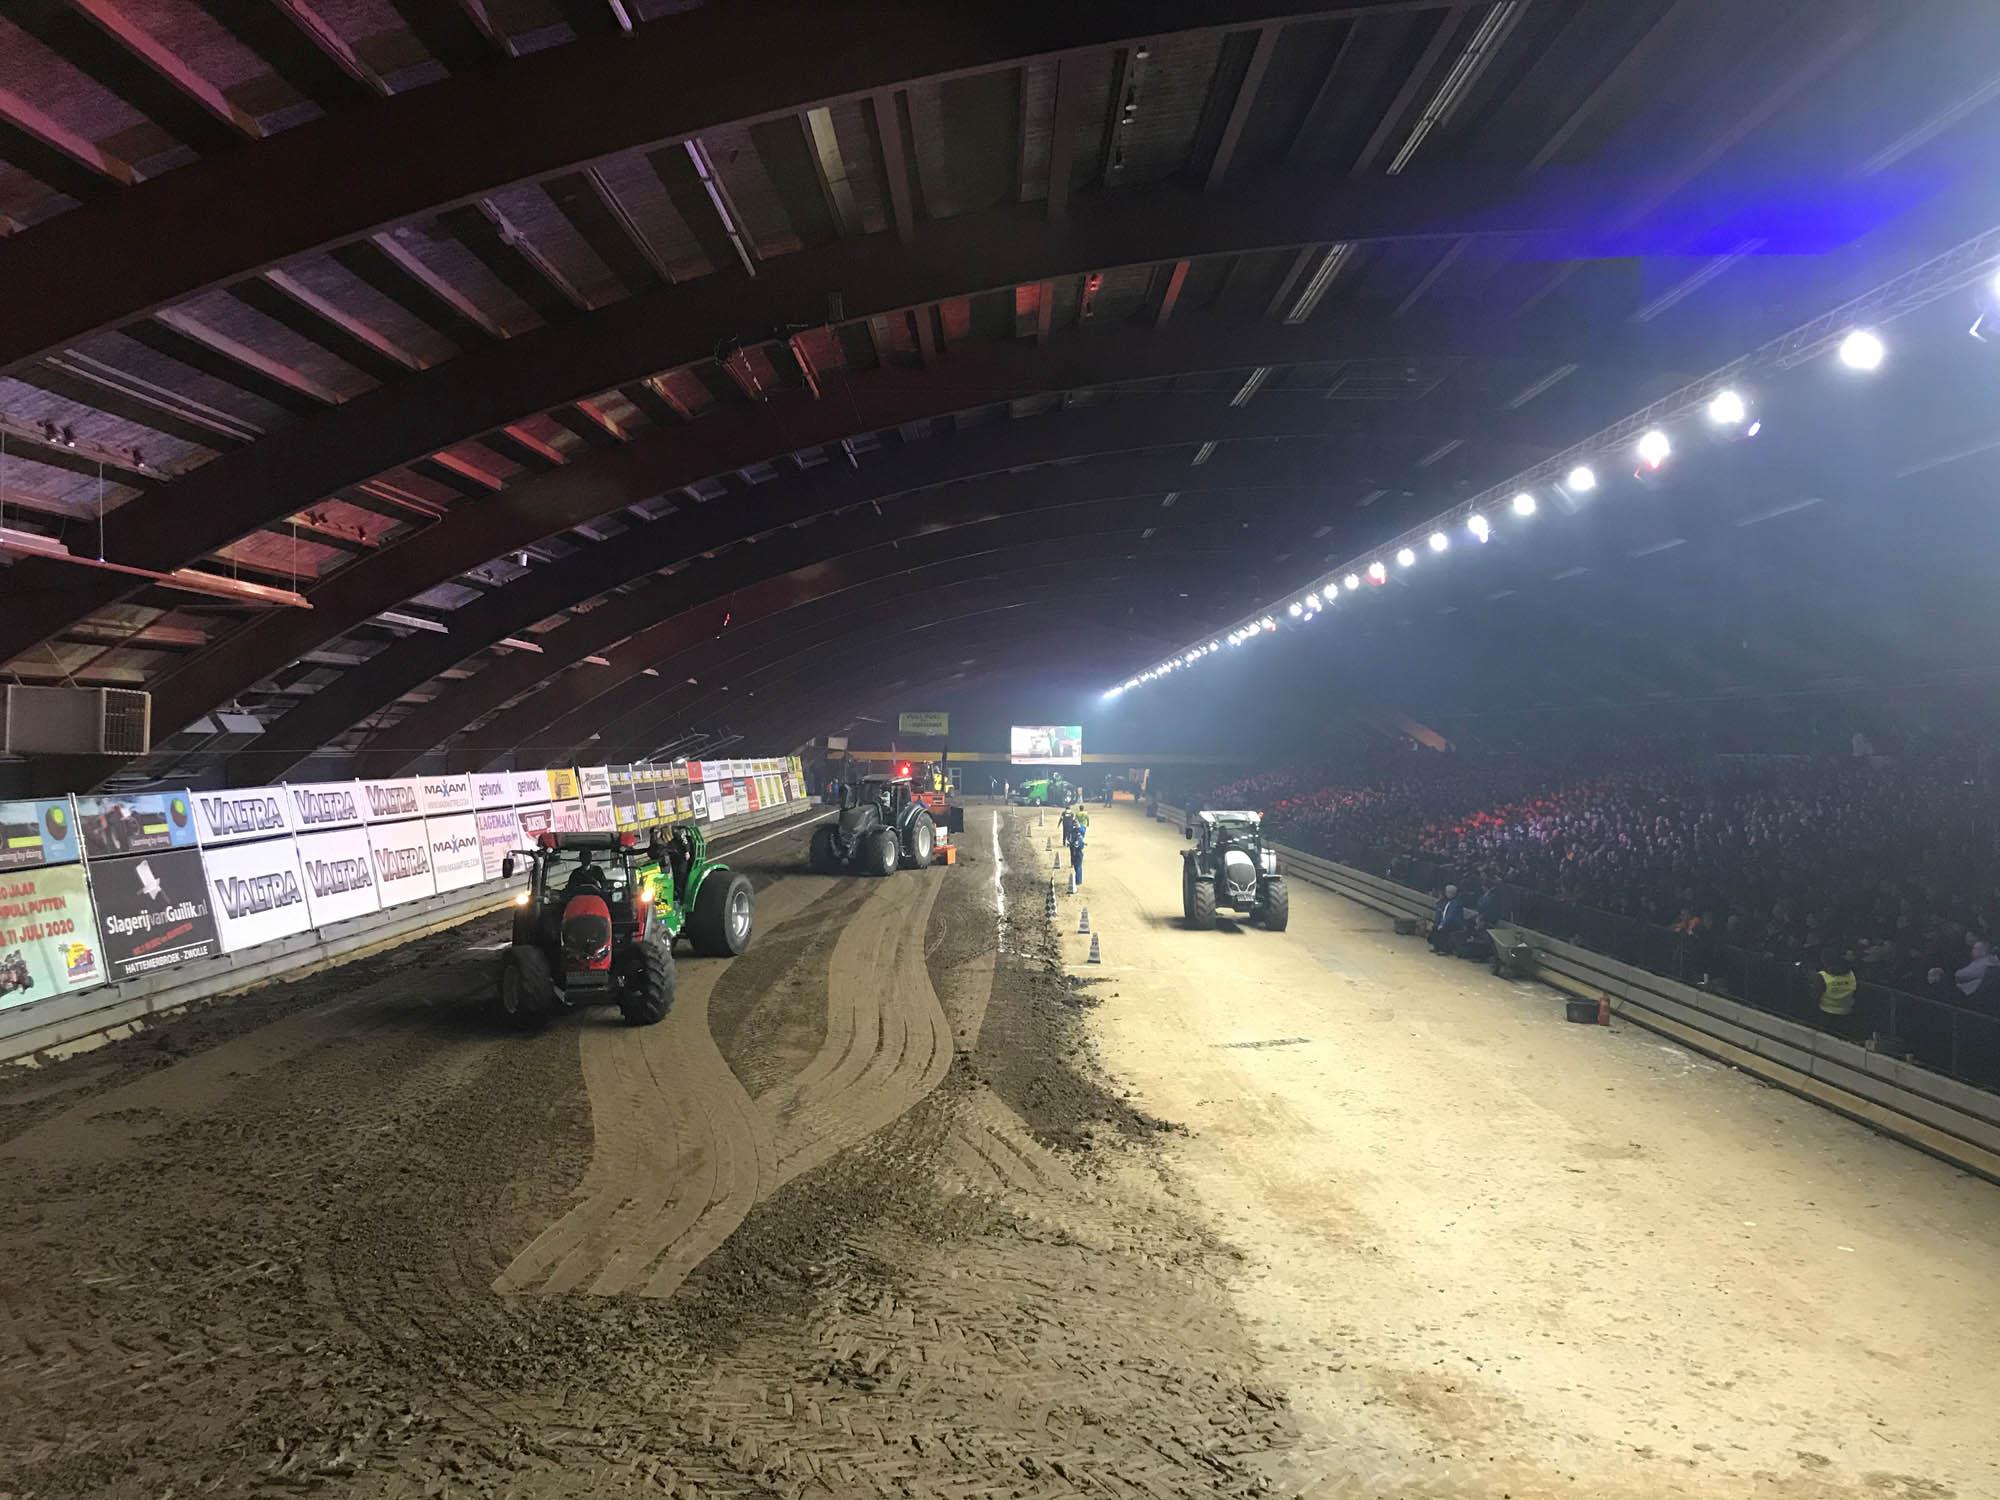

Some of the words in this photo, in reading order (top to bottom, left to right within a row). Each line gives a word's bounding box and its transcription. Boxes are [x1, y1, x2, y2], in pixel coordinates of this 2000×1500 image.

[365, 785, 418, 816] VALTRA
[424, 780, 467, 797] MAXAM
[200, 797, 285, 836] VALTRA
[294, 790, 358, 824] VALTRA
[433, 834, 477, 854] MAXAM
[305, 857, 373, 897] VALTRA
[374, 846, 430, 882] VALTRA
[214, 870, 302, 920] VALTRA
[19, 923, 45, 943] JULI
[45, 918, 75, 937] 2020
[183, 945, 209, 960] ZWOLLE
